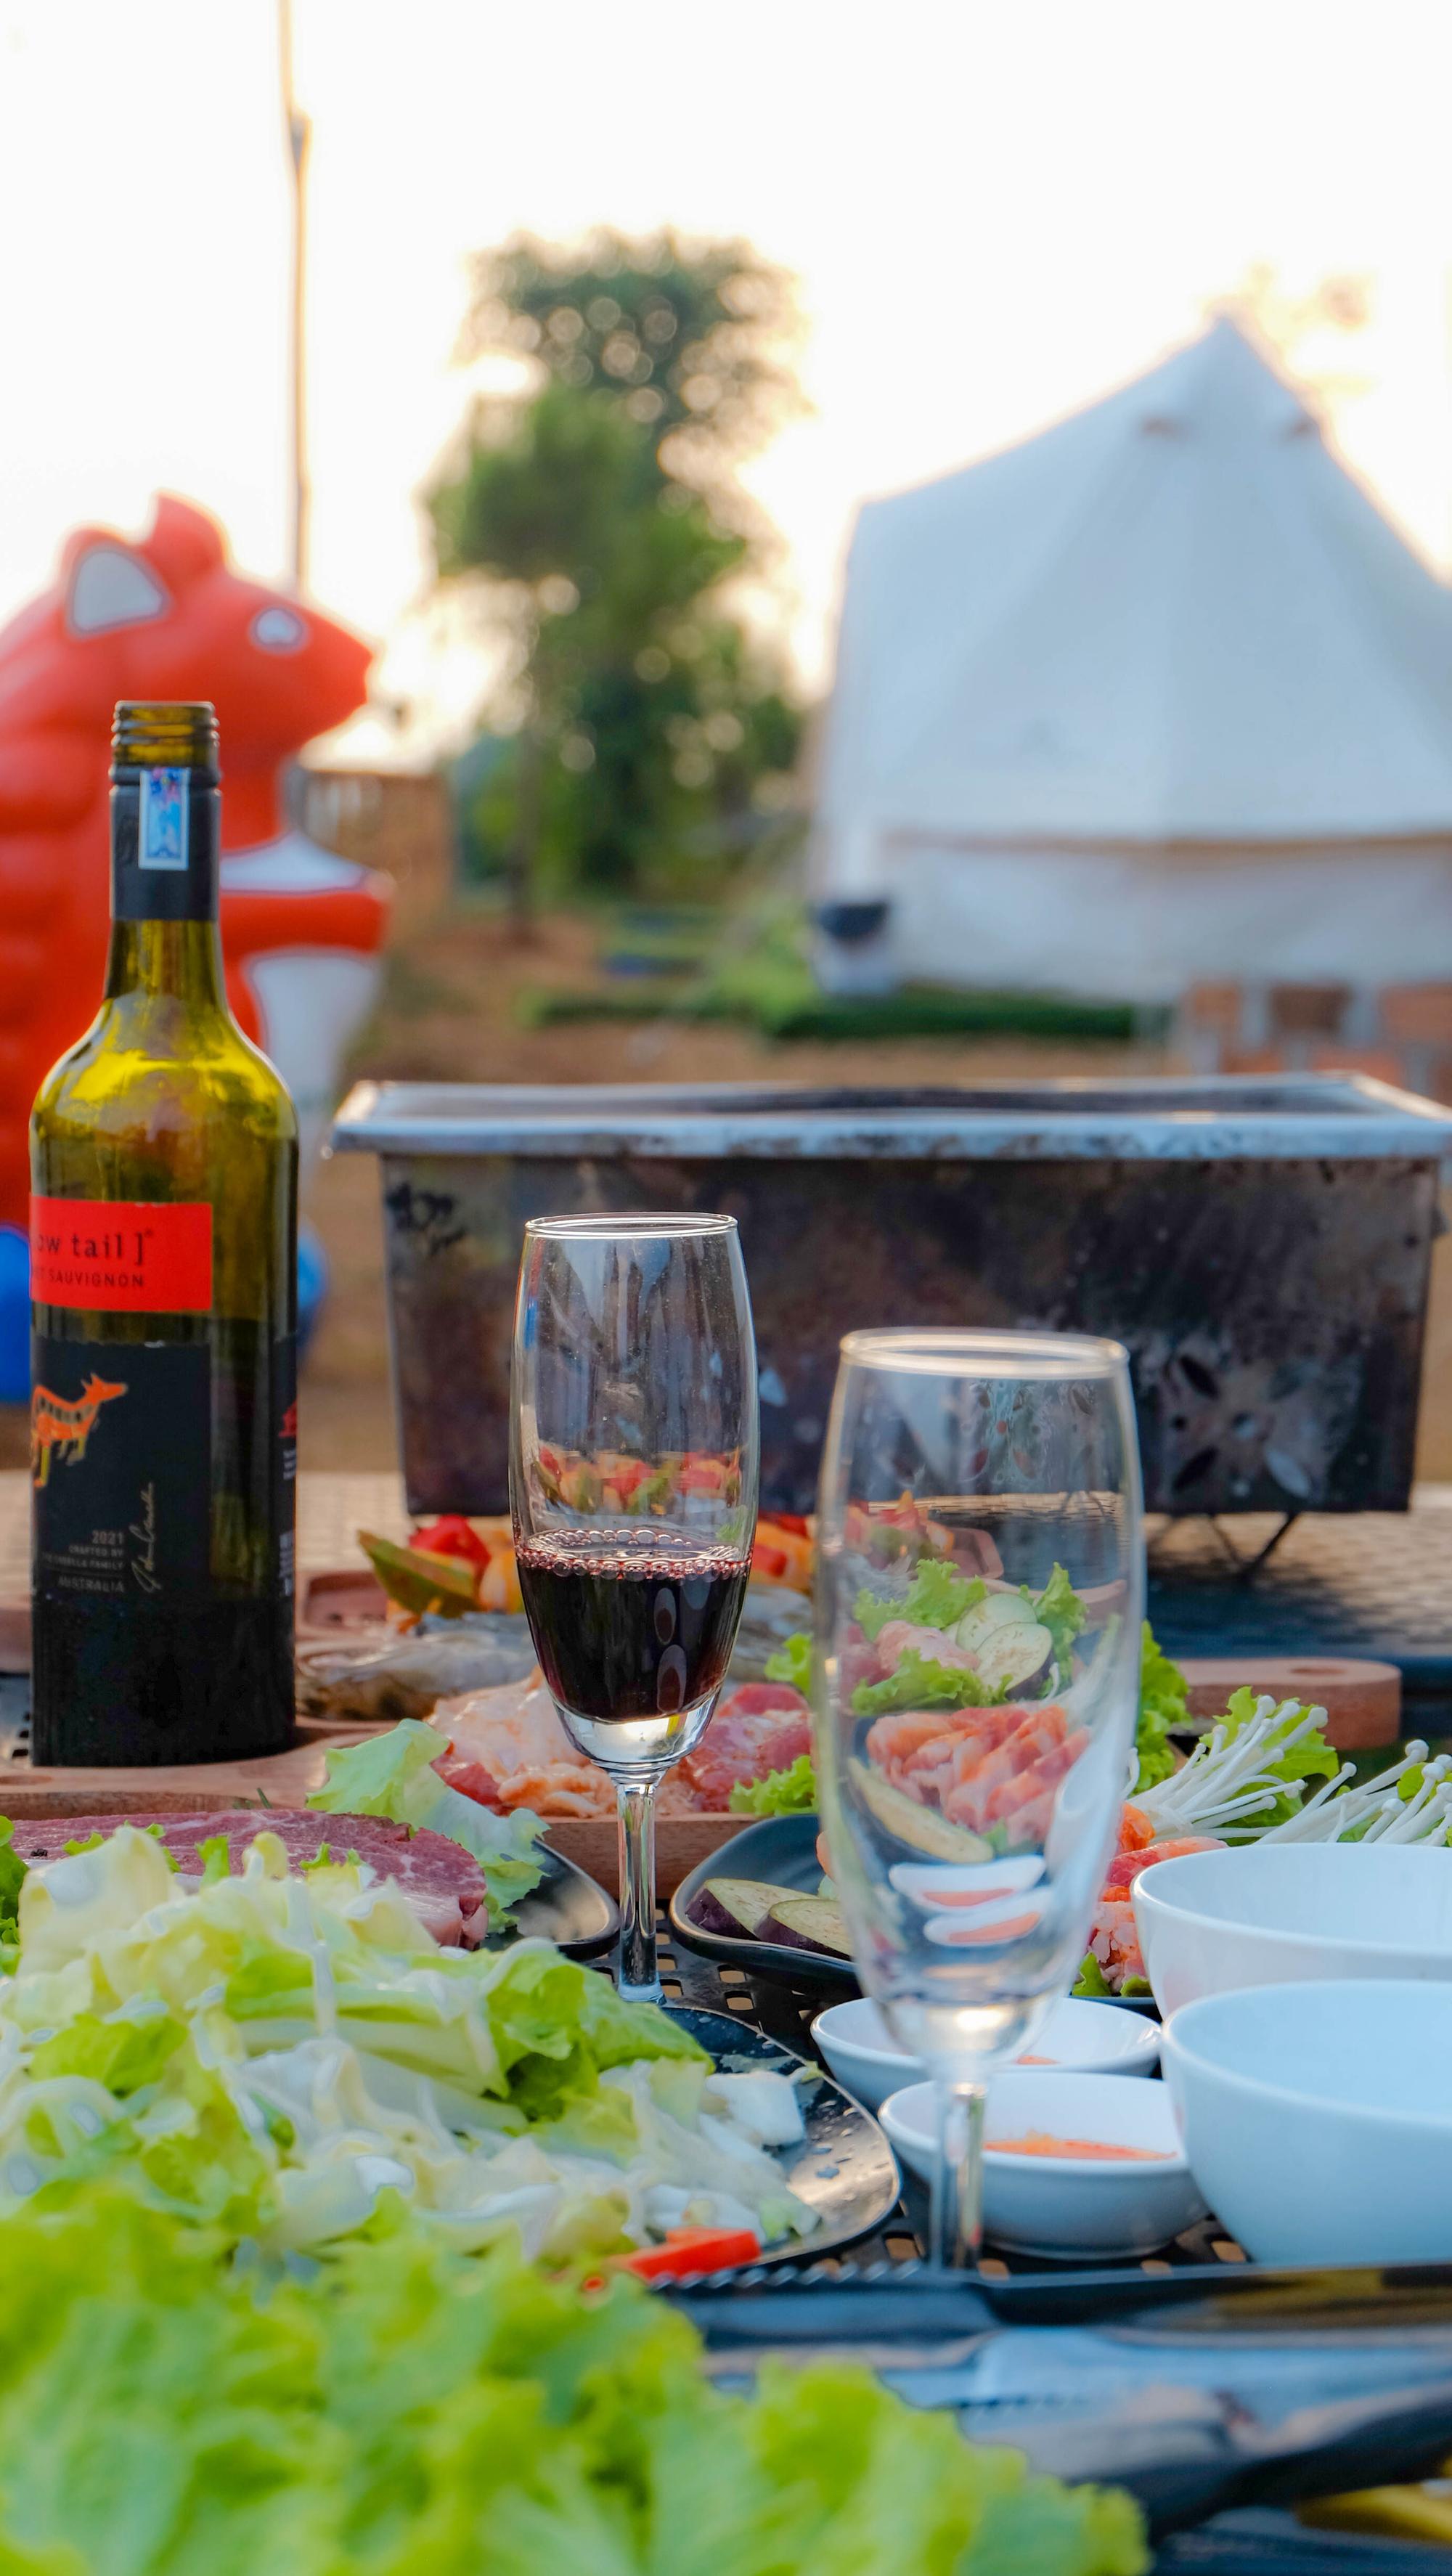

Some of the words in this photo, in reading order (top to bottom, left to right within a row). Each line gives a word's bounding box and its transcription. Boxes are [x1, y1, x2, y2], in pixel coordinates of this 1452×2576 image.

[48, 1267, 144, 1287] SAUVIGNON
[91, 1529, 124, 1545] 2021
[58, 1575, 124, 1592] AUSTRALIA
